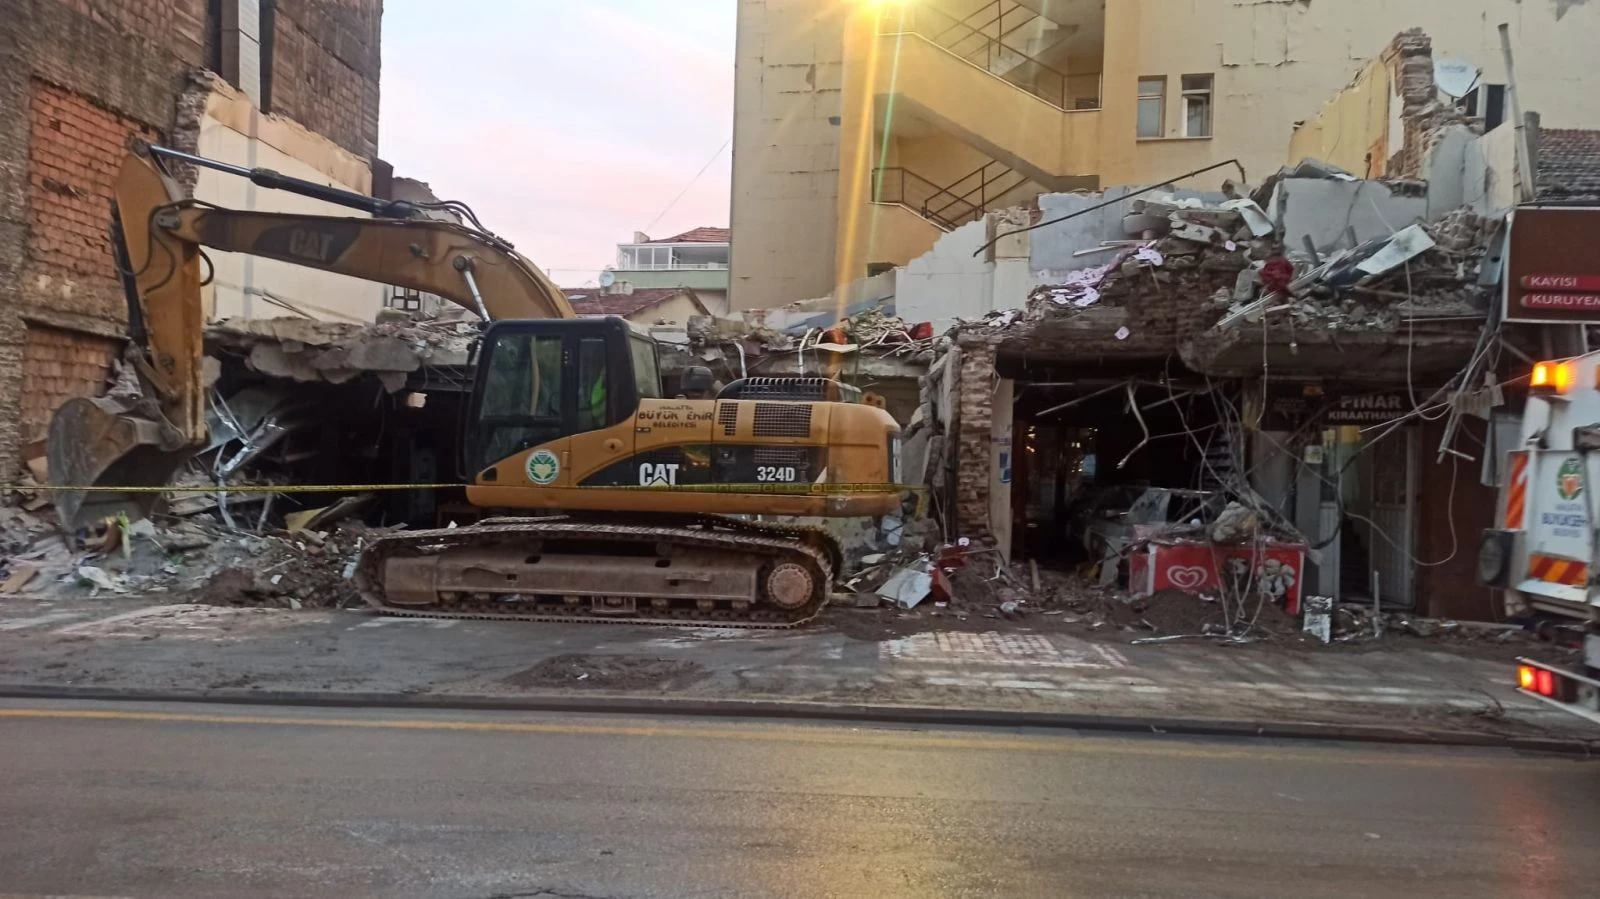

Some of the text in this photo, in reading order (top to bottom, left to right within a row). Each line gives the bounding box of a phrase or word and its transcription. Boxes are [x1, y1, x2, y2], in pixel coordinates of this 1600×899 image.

[1530, 276, 1577, 287] KAYISI
[639, 462, 679, 486] CAT
[757, 466, 795, 482] 324D
